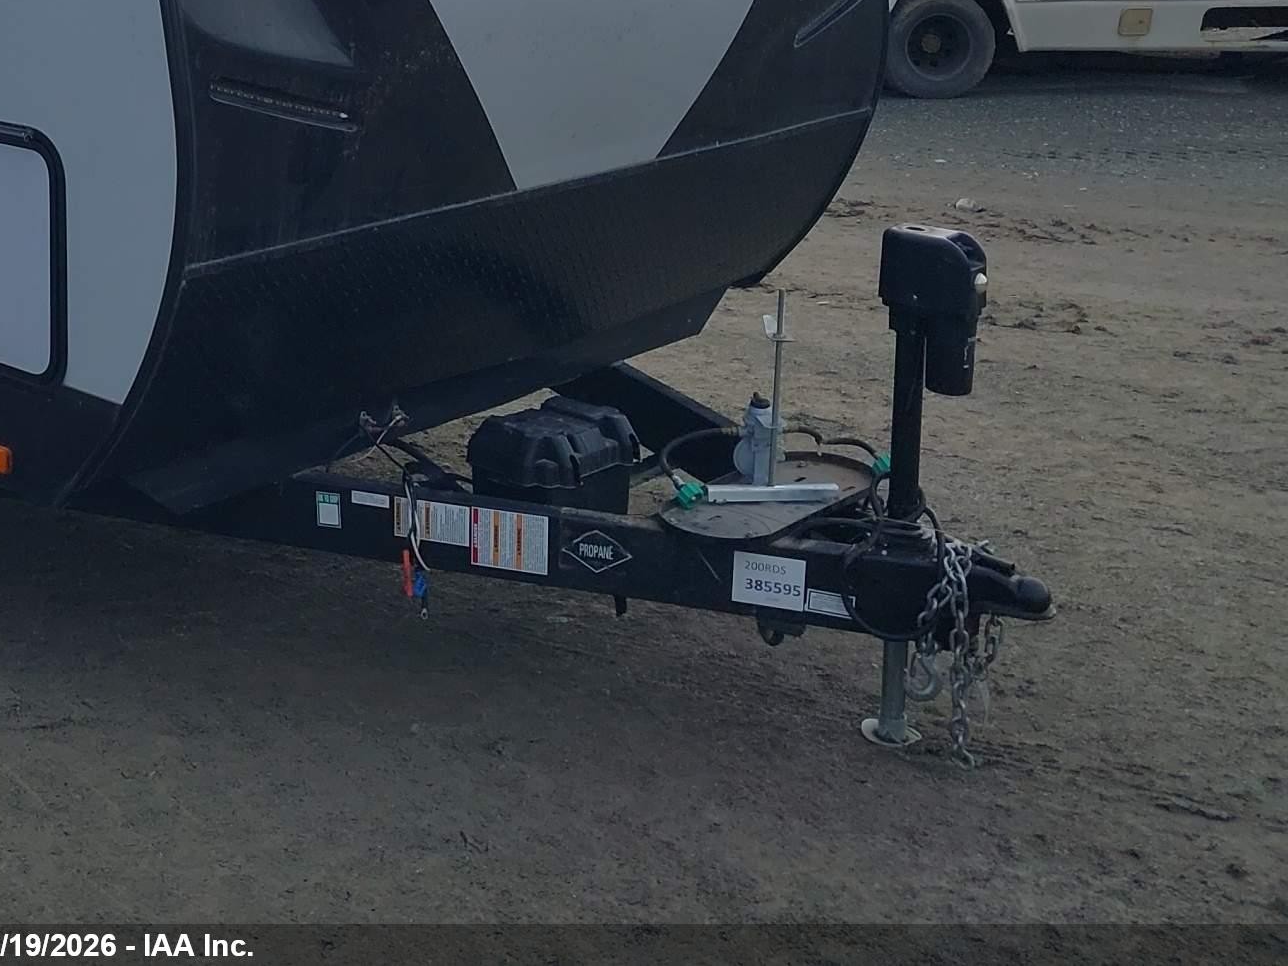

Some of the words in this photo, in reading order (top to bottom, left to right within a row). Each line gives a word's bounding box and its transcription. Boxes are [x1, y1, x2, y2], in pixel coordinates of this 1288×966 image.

[578, 542, 614, 560] PROPANE
[744, 559, 787, 576] 200RDS
[744, 577, 802, 598] 385595
